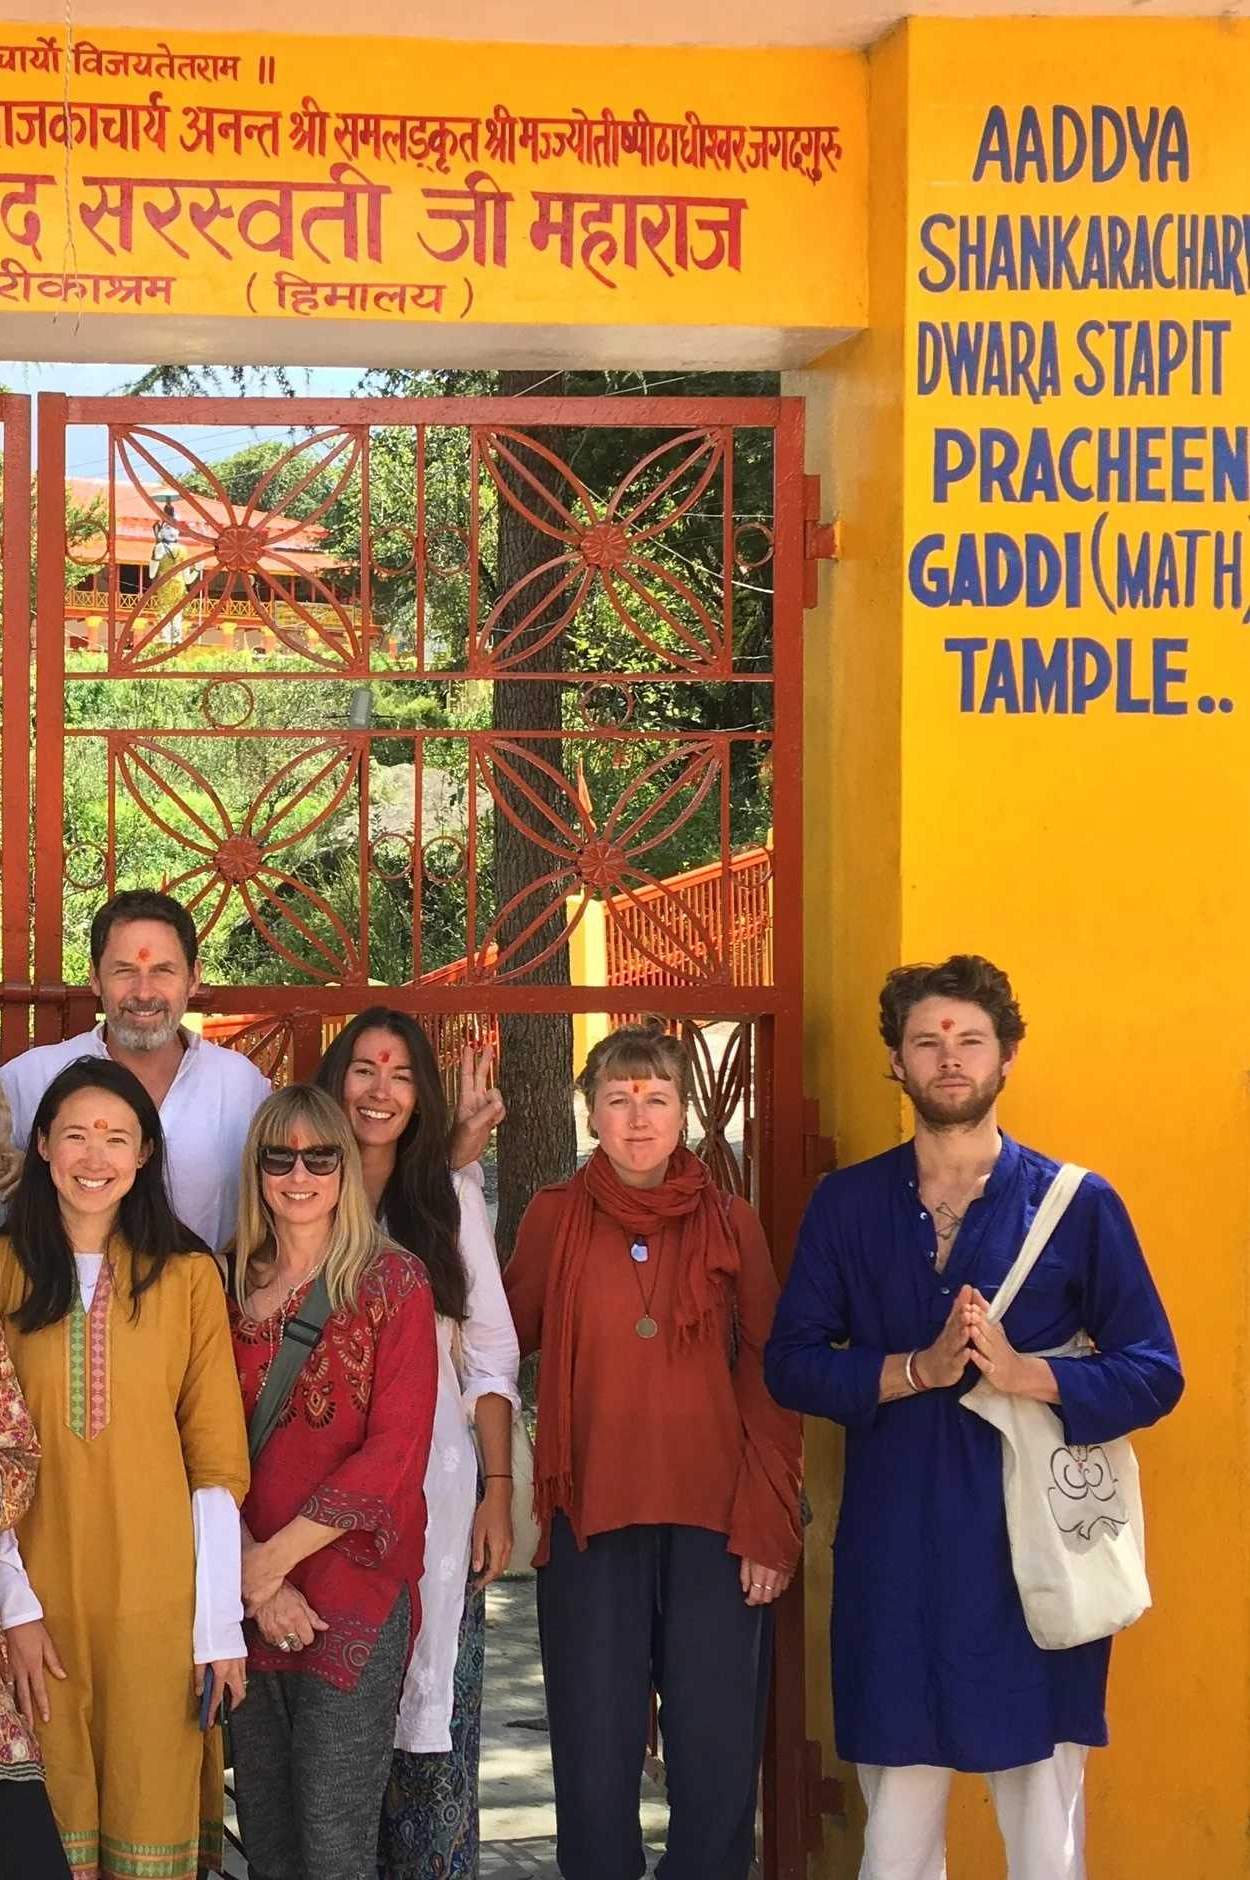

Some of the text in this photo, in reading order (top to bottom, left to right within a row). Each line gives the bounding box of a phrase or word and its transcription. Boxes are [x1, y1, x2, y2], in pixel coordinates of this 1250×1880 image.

[180, 106, 283, 160] अनन्त
[288, 95, 332, 158] श्री
[972, 104, 1189, 184] AADDYA
[79, 161, 393, 264] सरस्वती
[417, 166, 515, 268] जी
[530, 190, 749, 290] महाराज
[917, 320, 1231, 405] DWARA STAPIT
[933, 426, 1250, 503] PRACHEEN
[908, 512, 1250, 625] GADDI (MATH
